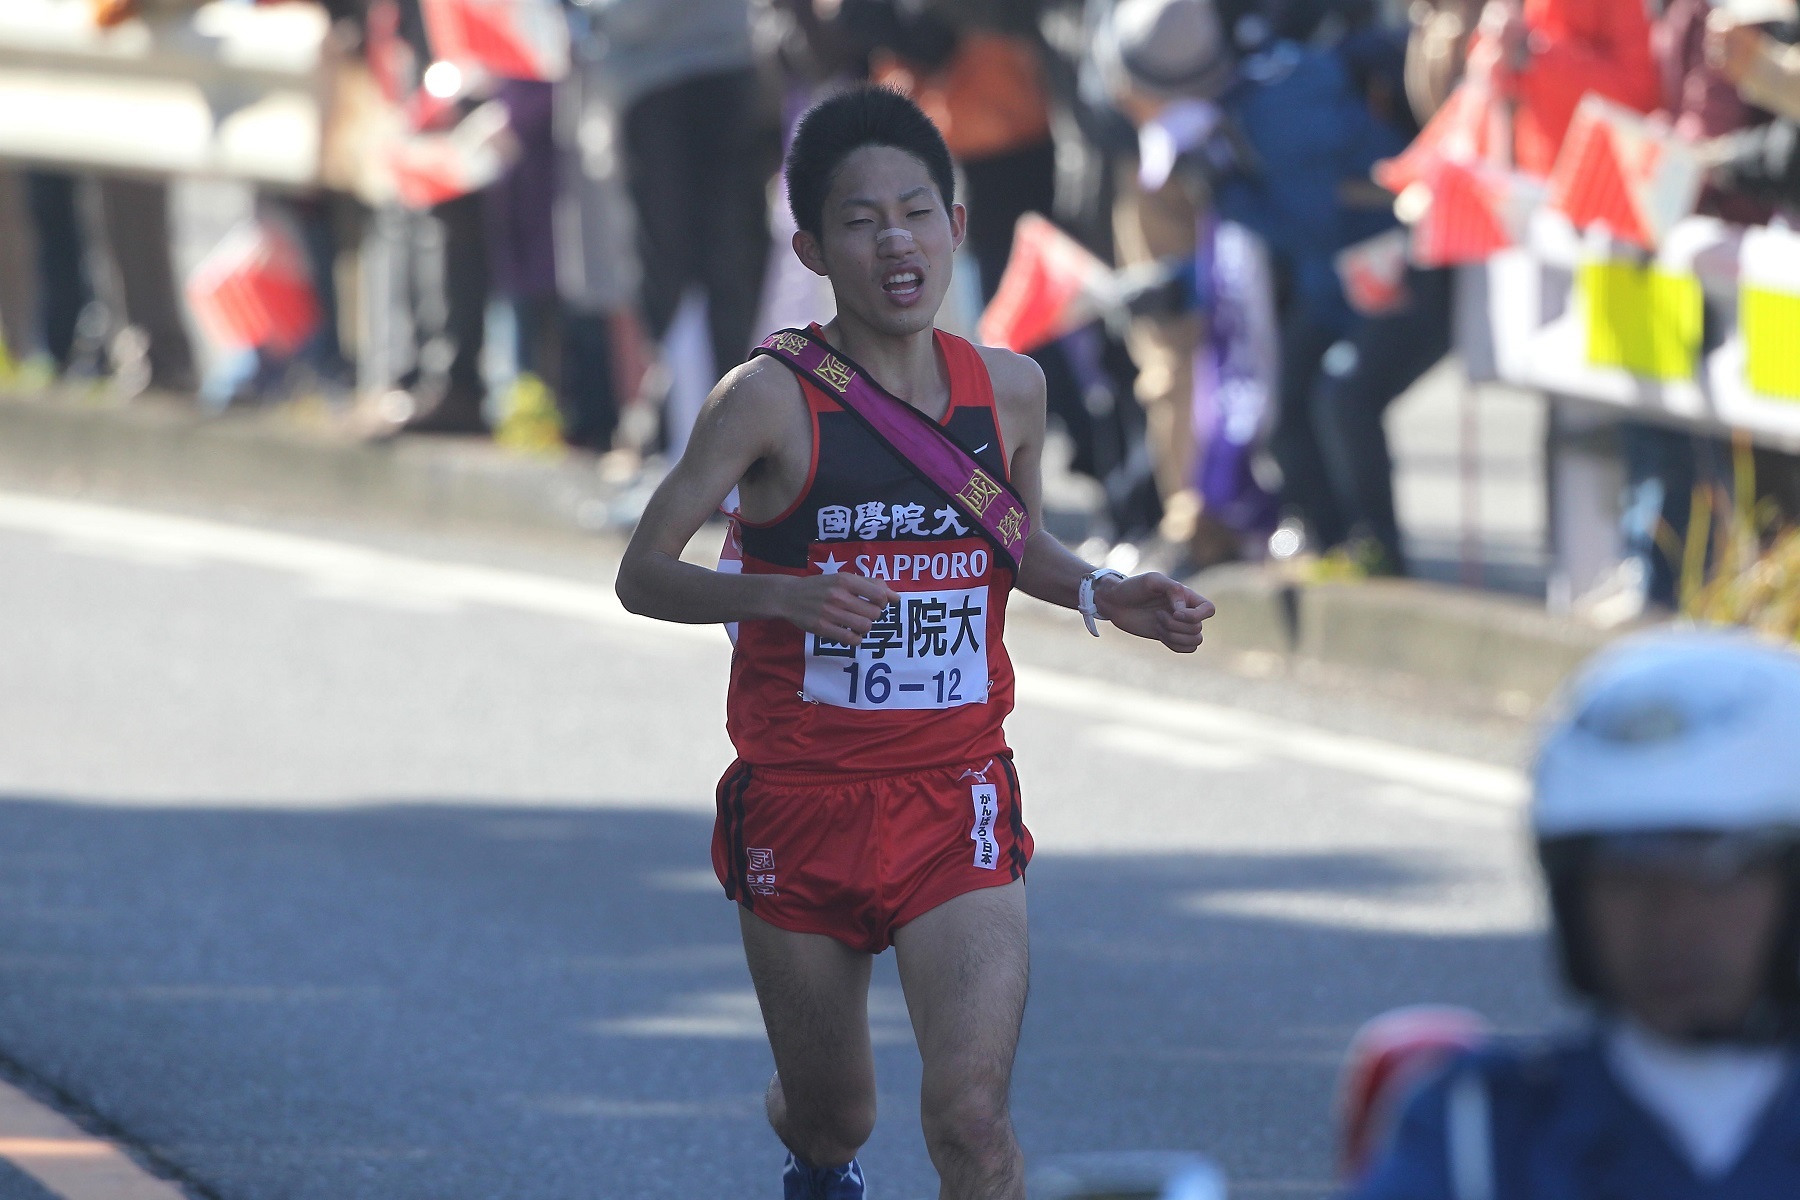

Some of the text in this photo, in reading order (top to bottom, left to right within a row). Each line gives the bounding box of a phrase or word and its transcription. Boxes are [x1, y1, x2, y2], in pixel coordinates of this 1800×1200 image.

[817, 500, 980, 541] 國學院大
[855, 549, 988, 581] SAPPORO
